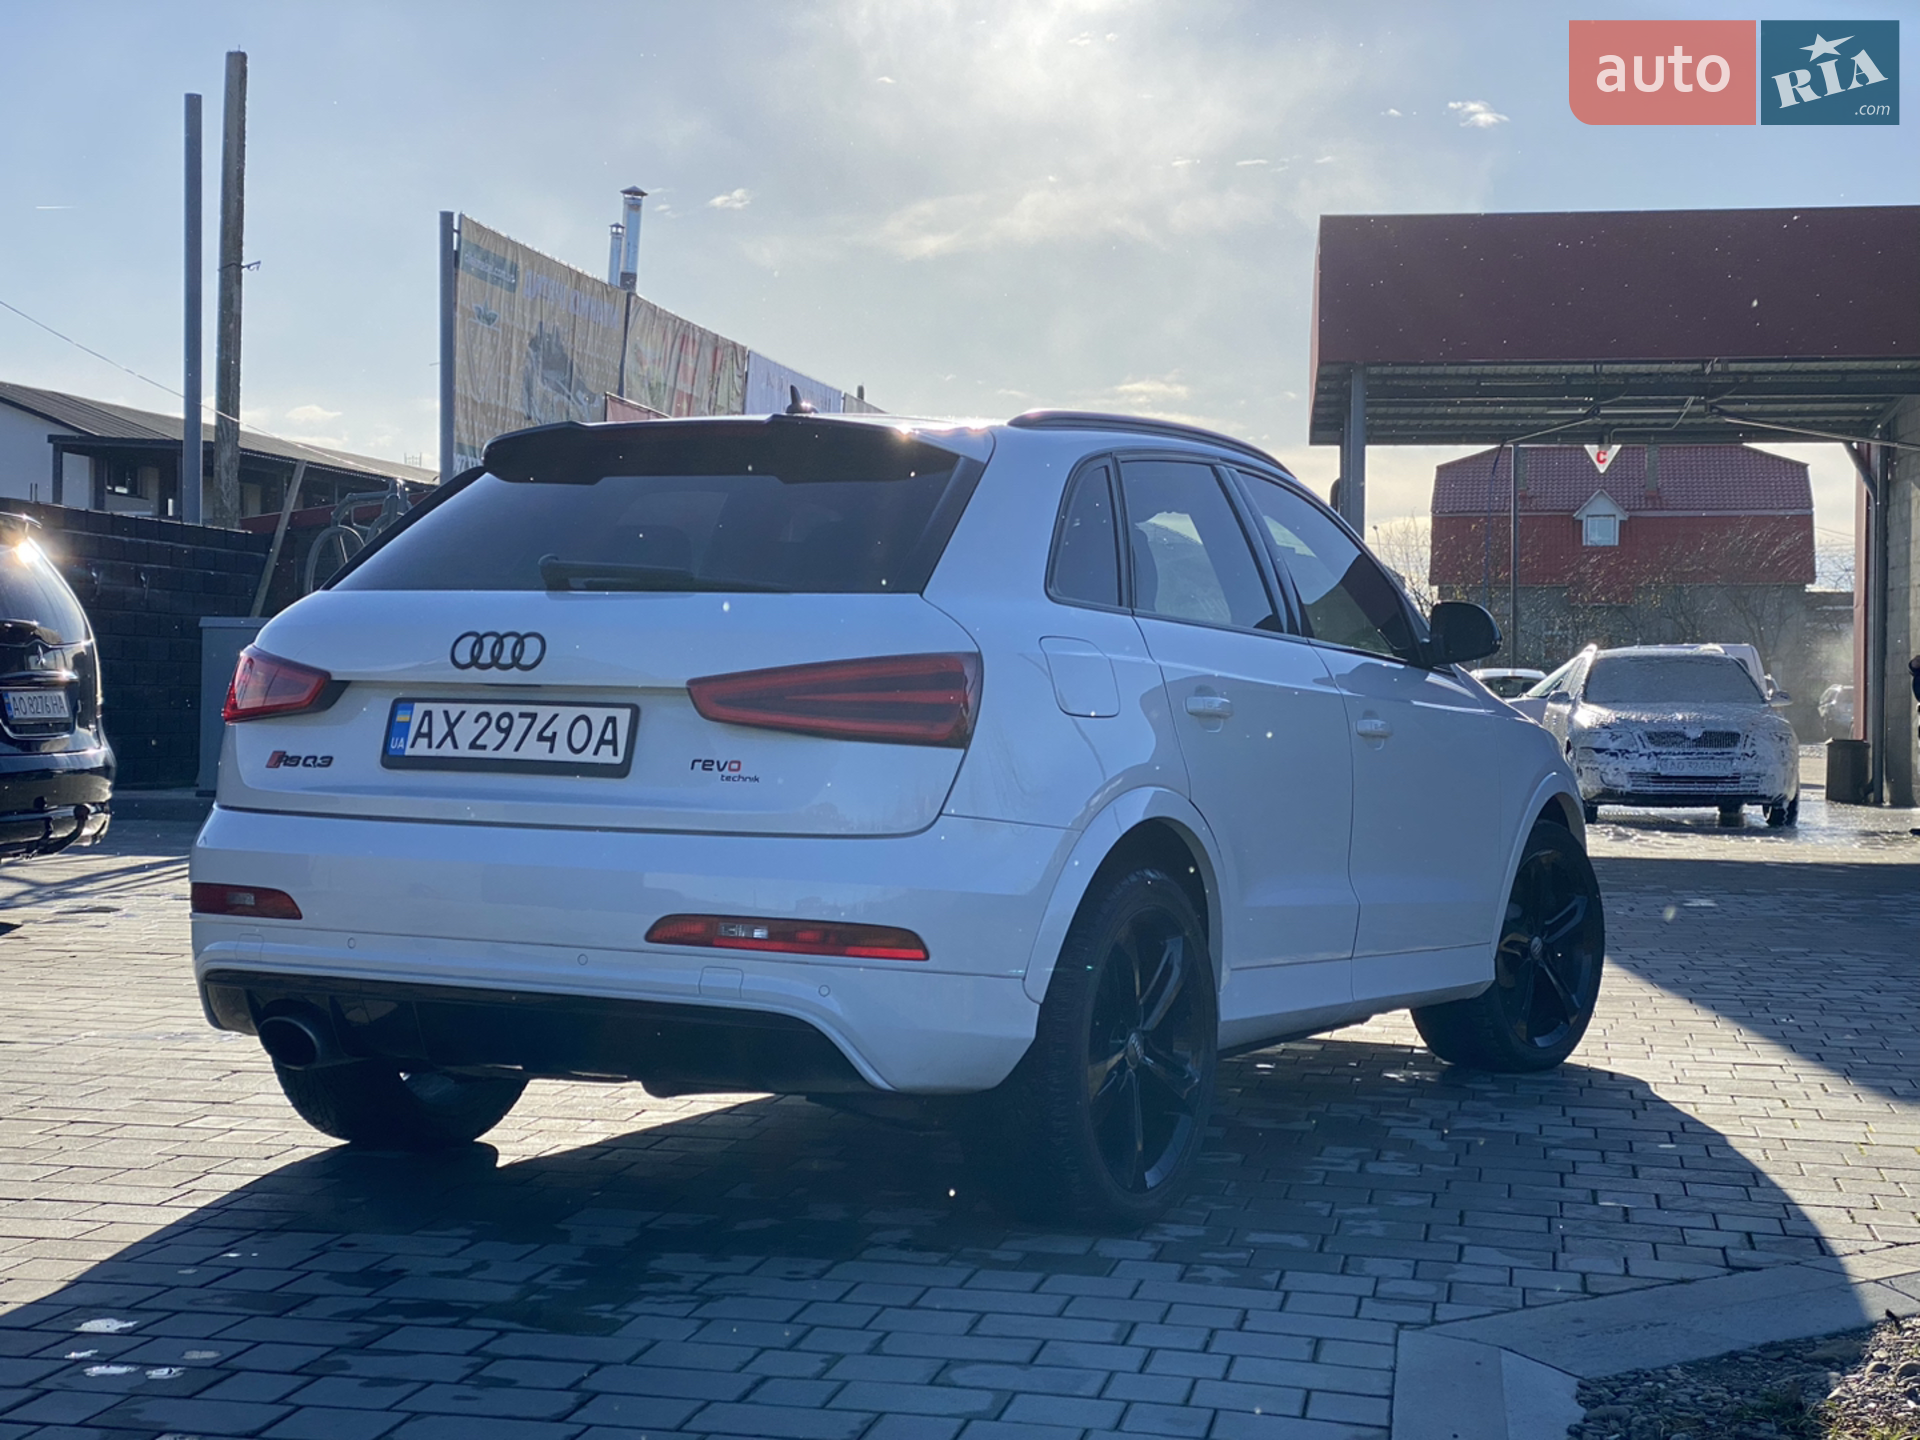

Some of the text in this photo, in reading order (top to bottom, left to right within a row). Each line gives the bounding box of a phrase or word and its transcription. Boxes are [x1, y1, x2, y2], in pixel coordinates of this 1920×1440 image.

[409, 709, 619, 757] AX 2974 OA
[391, 737, 404, 749] UA
[690, 759, 742, 772] revo
[720, 774, 760, 783] technik
